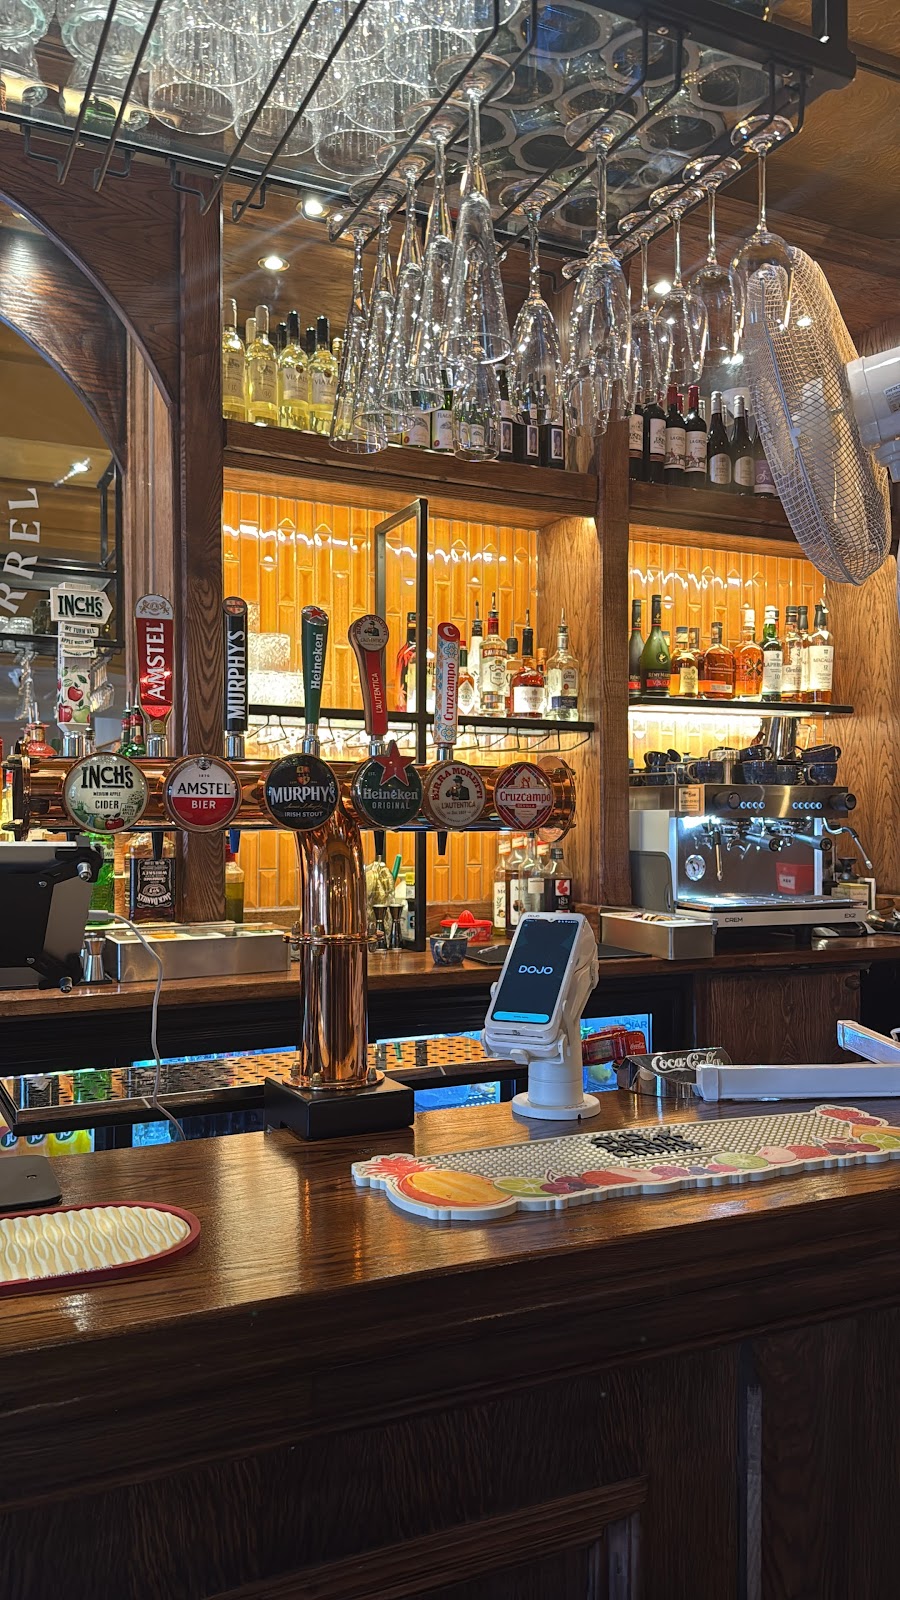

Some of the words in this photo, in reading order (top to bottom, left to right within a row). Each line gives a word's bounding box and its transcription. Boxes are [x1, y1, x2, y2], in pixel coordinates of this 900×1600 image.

[57, 594, 104, 618] INCH'S
[146, 621, 166, 700] AMSTEL
[310, 633, 325, 690] Heineken
[371, 672, 383, 714] L'AUTENTICA
[443, 662, 457, 721] Cruzcampo
[81, 765, 134, 789] INCH'S
[177, 782, 231, 795] AMSTEL
[432, 770, 452, 801] BIRRA
[451, 767, 483, 800] MORETTI
[363, 788, 418, 800] Heineken
[500, 791, 551, 803] Cruzcampo
[95, 800, 119, 809] CIDER
[191, 800, 216, 809] BIER
[371, 801, 410, 810] ORIGINAL
[441, 801, 476, 809] L'AUTENTICA
[518, 965, 553, 975] DOJO
